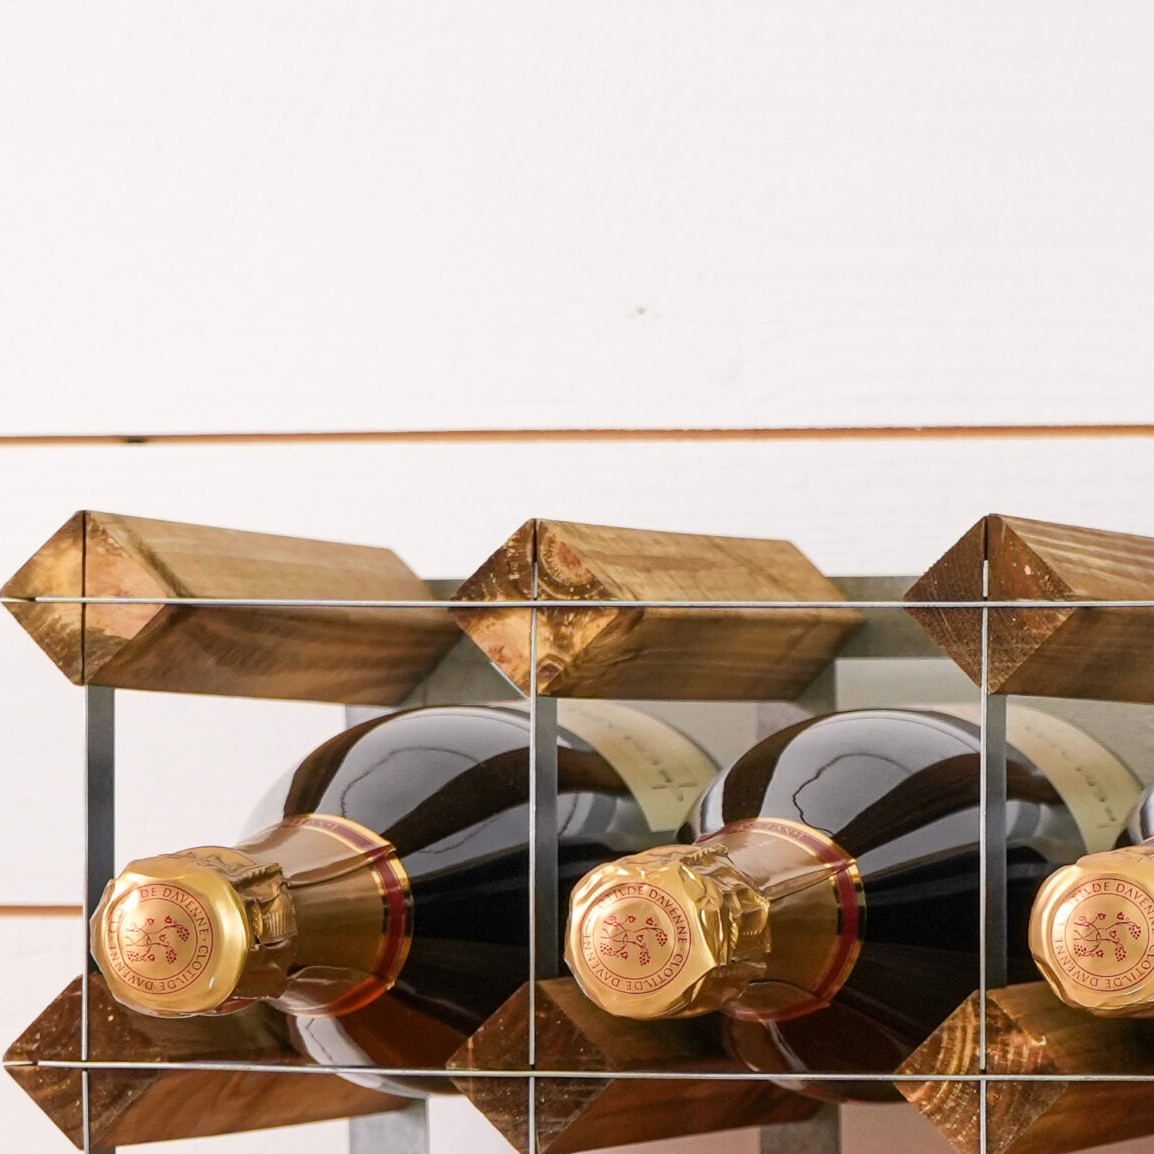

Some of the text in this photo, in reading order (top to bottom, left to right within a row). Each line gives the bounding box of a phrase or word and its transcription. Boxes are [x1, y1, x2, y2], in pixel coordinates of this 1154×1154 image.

[163, 887, 209, 935] DAVENNE
[649, 889, 688, 943] DAVENNE
[108, 944, 209, 991] CLOTILDE DAVENNE
[582, 935, 684, 991] CLOTILDE DAVENNE
[1055, 938, 1099, 988] DAVENNE
